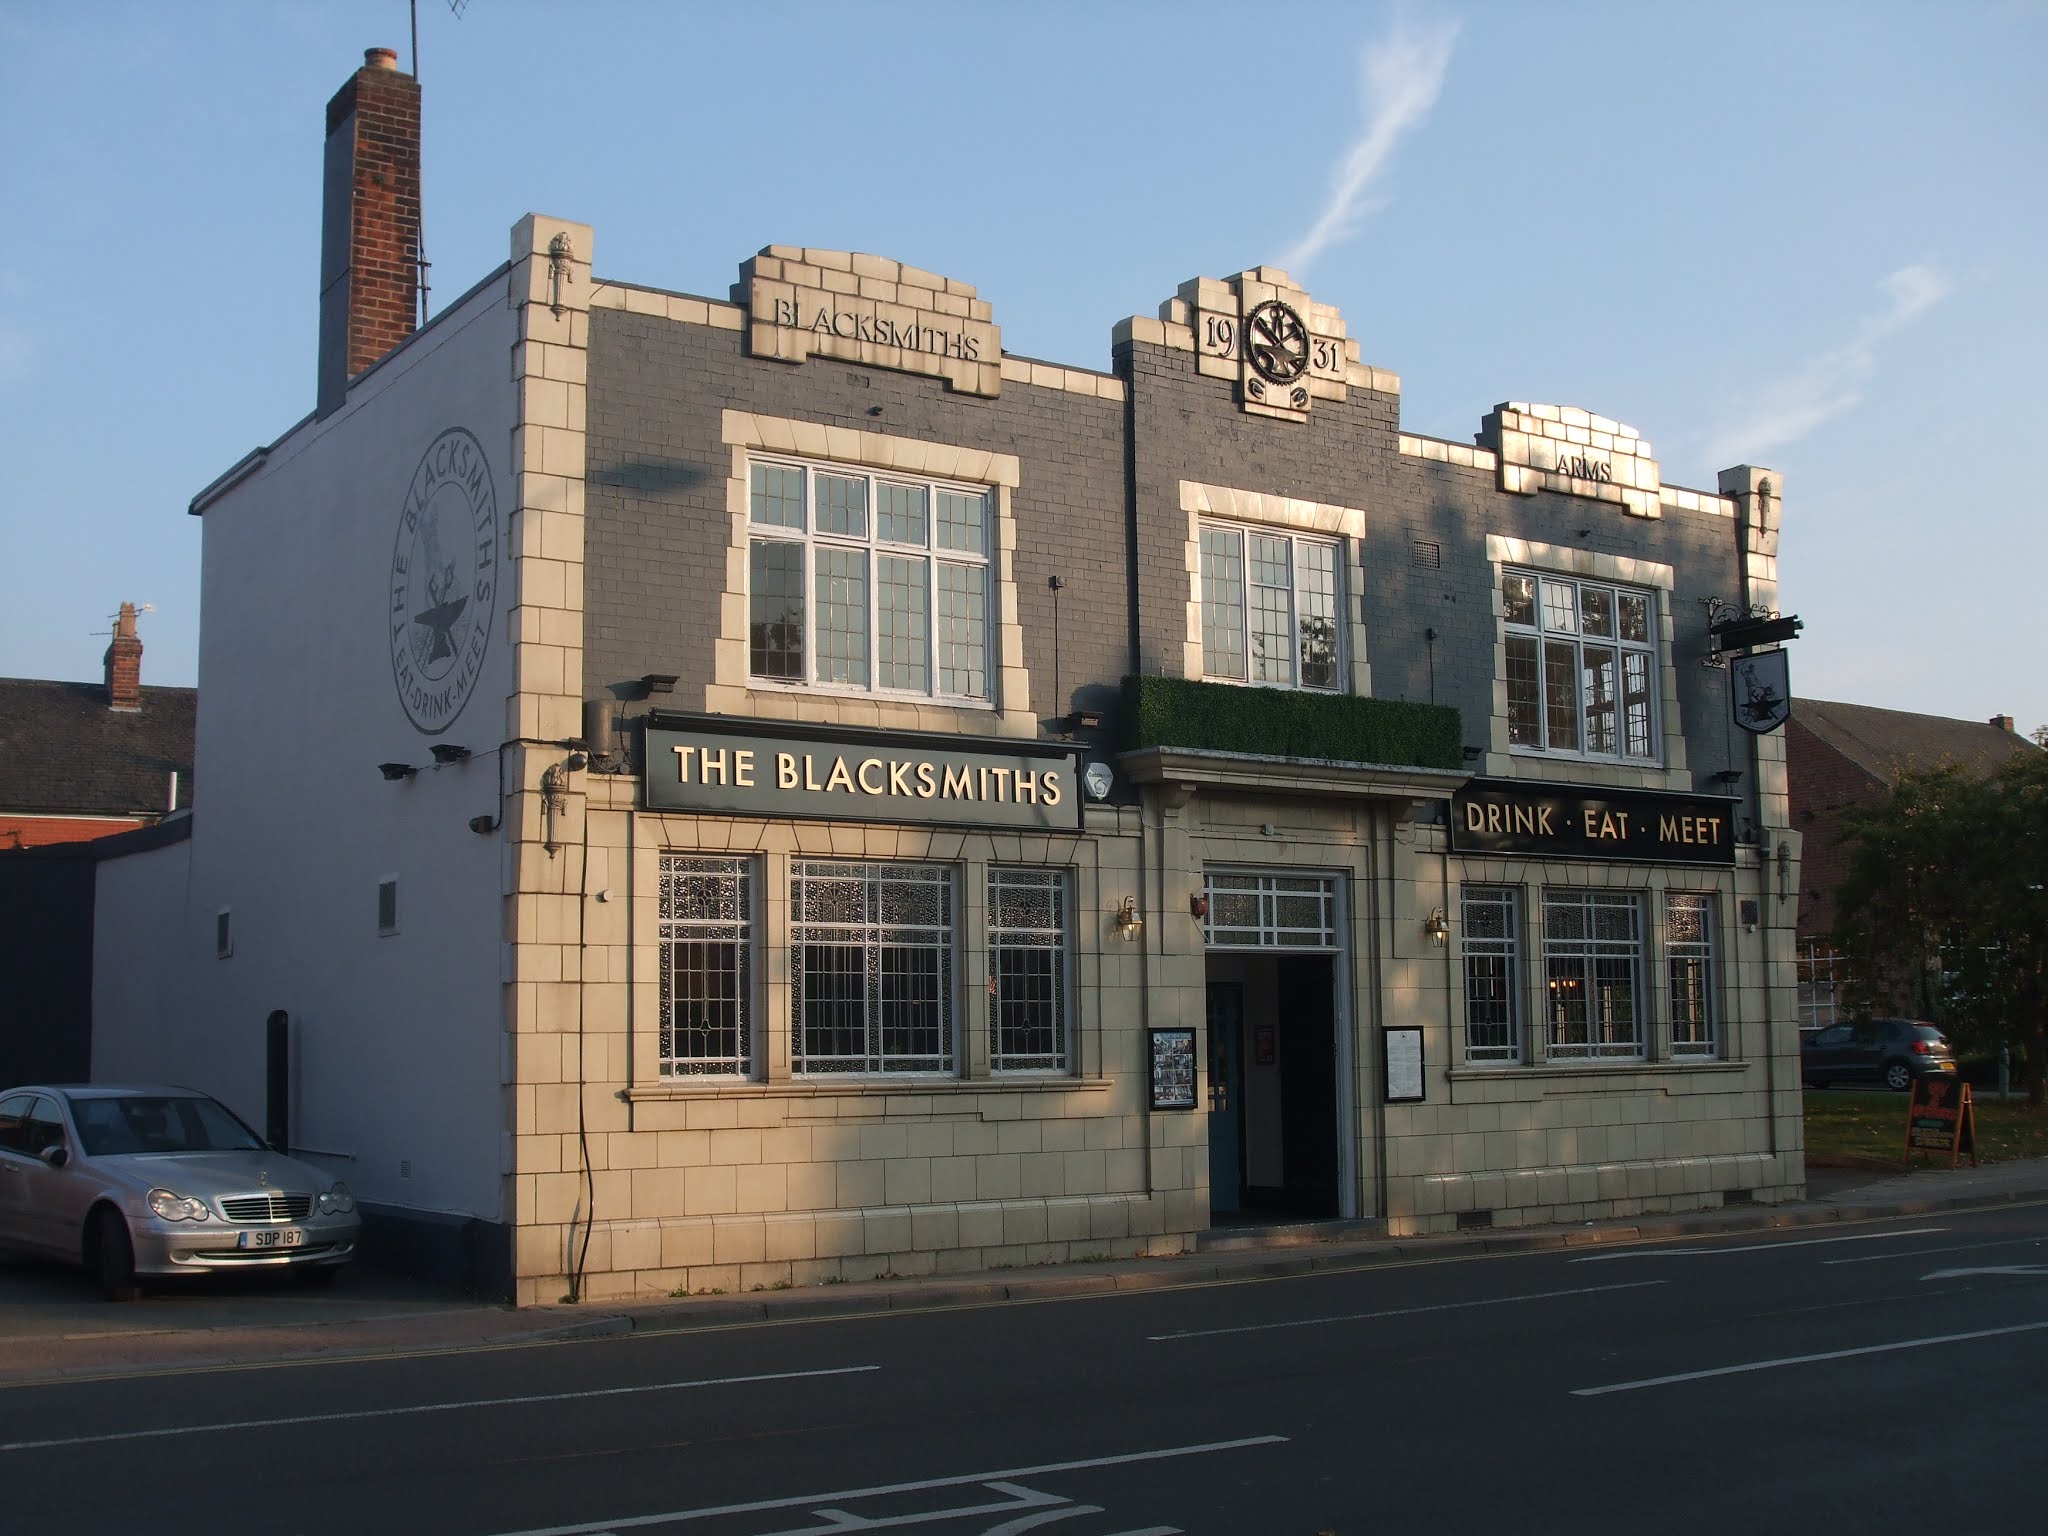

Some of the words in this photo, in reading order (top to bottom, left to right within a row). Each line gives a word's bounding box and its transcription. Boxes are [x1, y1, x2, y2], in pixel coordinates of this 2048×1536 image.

[775, 298, 980, 360] BLACKSMITHS
[1207, 316, 1236, 358] 19
[1313, 339, 1340, 372] 31
[1556, 454, 1612, 482] ARMS
[392, 553, 409, 643] THE
[404, 439, 493, 603] BLACKSMITHS
[455, 623, 485, 700] MEET
[673, 745, 755, 787] THE
[776, 752, 1061, 806] BLACKSMITHS
[1466, 802, 1554, 836] DRINK
[1584, 809, 1628, 840] EAT
[1659, 814, 1720, 845] MEET
[255, 1232, 280, 1246] SDP
[283, 1231, 302, 1244] 187
